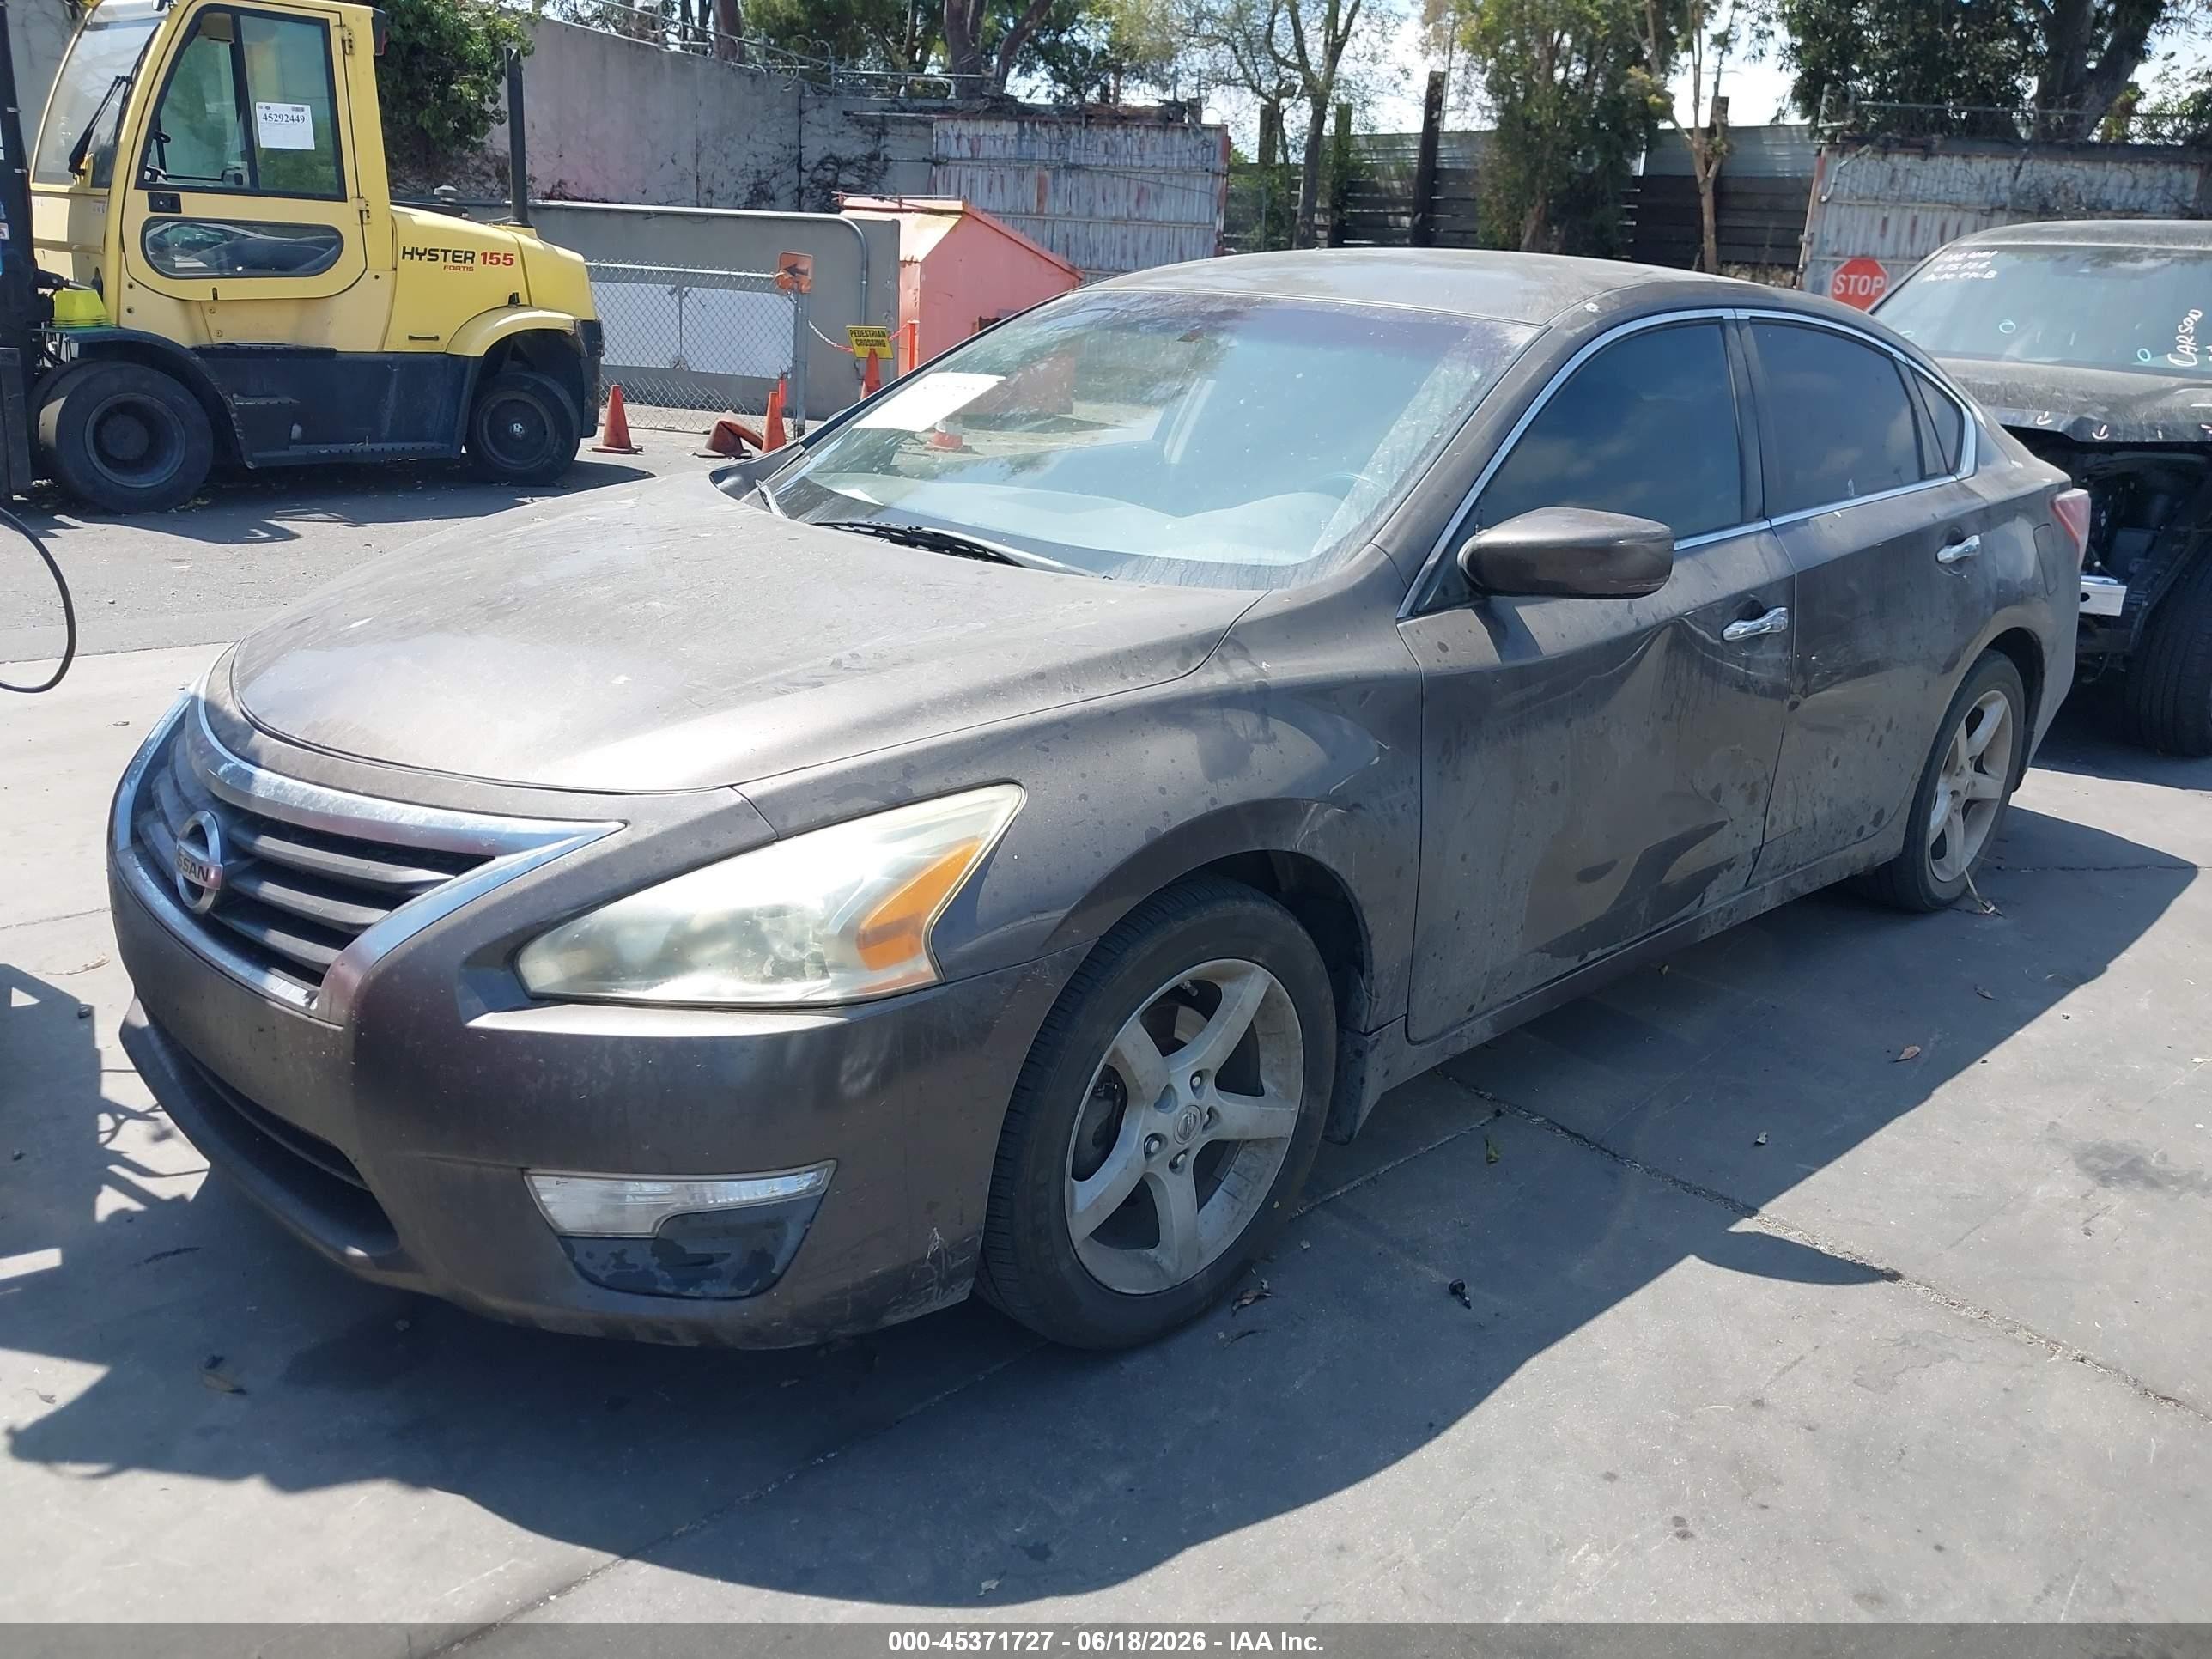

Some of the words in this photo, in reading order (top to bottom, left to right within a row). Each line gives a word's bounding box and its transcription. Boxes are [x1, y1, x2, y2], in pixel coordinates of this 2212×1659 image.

[262, 113, 306, 124] 45292449
[401, 246, 476, 264] HYSTER
[480, 252, 514, 267] 155
[1833, 274, 1885, 296] STOP
[849, 329, 887, 337] PEDESTRIAN
[855, 338, 886, 348] CROSSING
